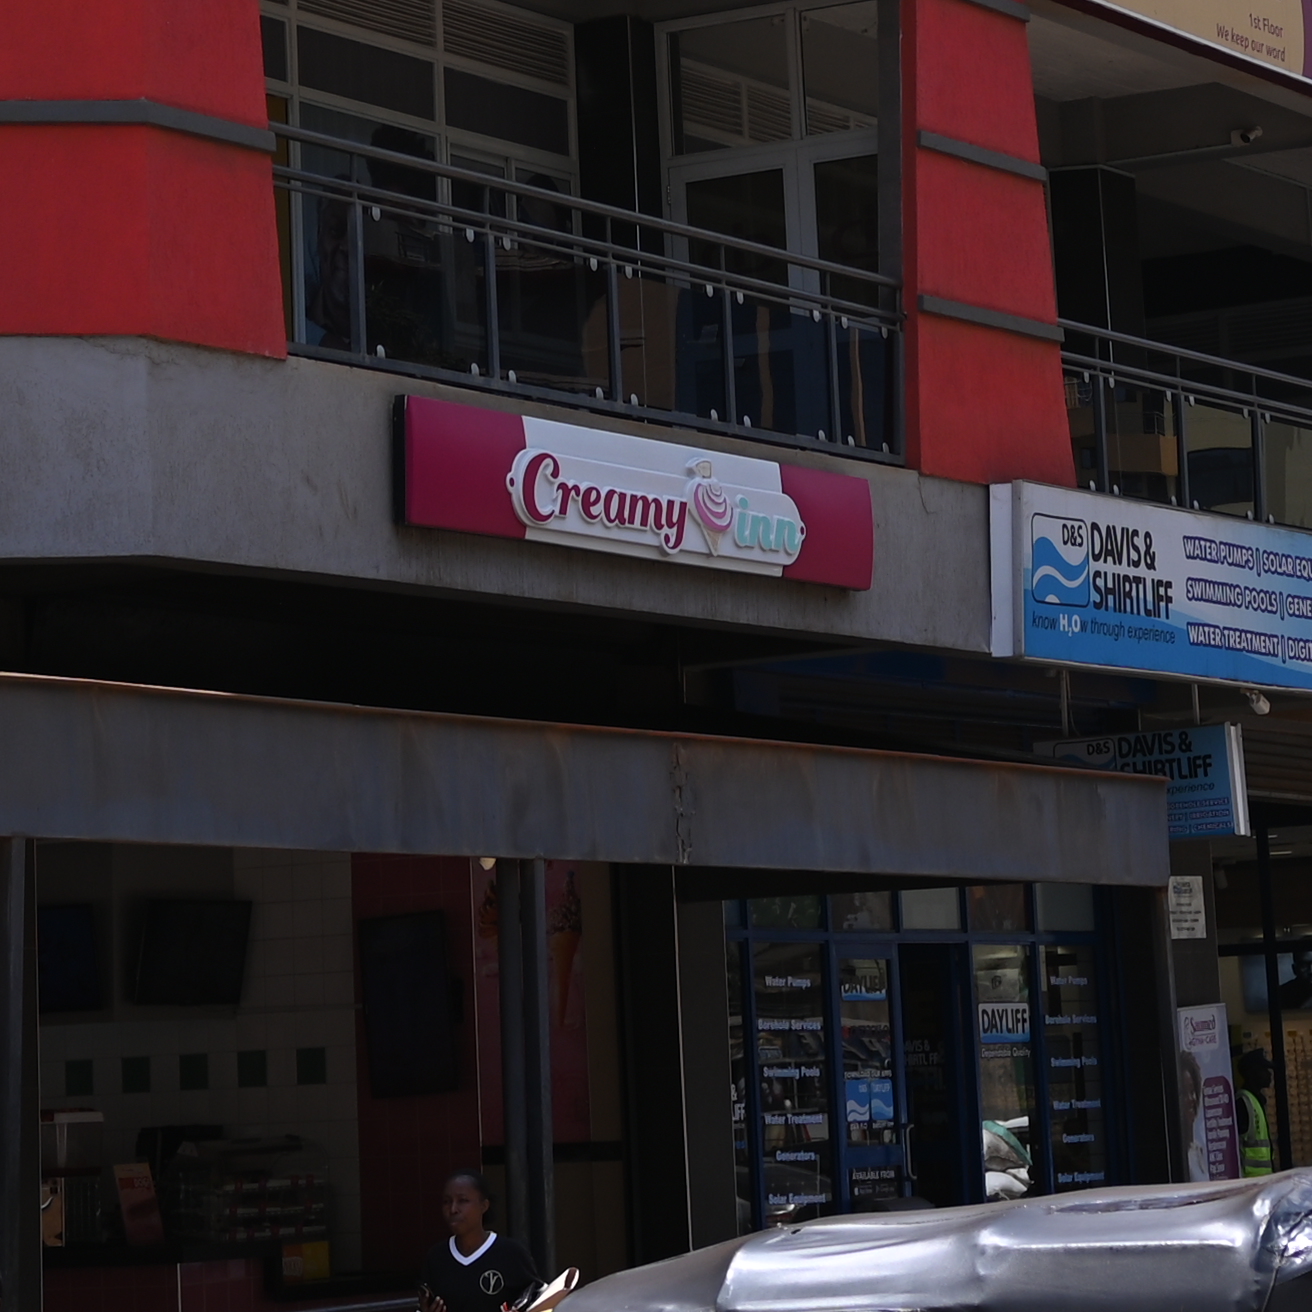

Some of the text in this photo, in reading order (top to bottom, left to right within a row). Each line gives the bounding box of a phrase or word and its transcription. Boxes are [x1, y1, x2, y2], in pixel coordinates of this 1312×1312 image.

[1248, 12, 1285, 39] 1st Floor
[1216, 22, 1286, 64] We keep our word
[521, 451, 801, 555] Creamy inn
[1062, 523, 1084, 548] D&S
[1090, 521, 1157, 571] DAVIS &
[1183, 536, 1219, 564] WATER
[1220, 541, 1255, 571] PUMPS
[1262, 550, 1294, 577] SOLAR
[1092, 570, 1174, 620] SHIRTLIFF
[1186, 577, 1243, 608] SWIMMING
[1244, 591, 1279, 616] POOLS
[1031, 610, 1176, 645] know through experience
[1187, 622, 1223, 649] WATER
[1223, 629, 1280, 658] TREATMENT
[1087, 741, 1111, 756] D&S
[1117, 731, 1193, 759] DAVIS &
[764, 976, 811, 990] Water Pumps
[790, 1019, 822, 1032] Services
[982, 1008, 1029, 1035] DAYLIFF
[1012, 1047, 1032, 1060] Quality
[763, 1066, 821, 1080] Swimming Pools
[764, 1113, 824, 1126] Water Treatment
[775, 1150, 816, 1162] Generators
[768, 1193, 827, 1206] Solar Equipment
